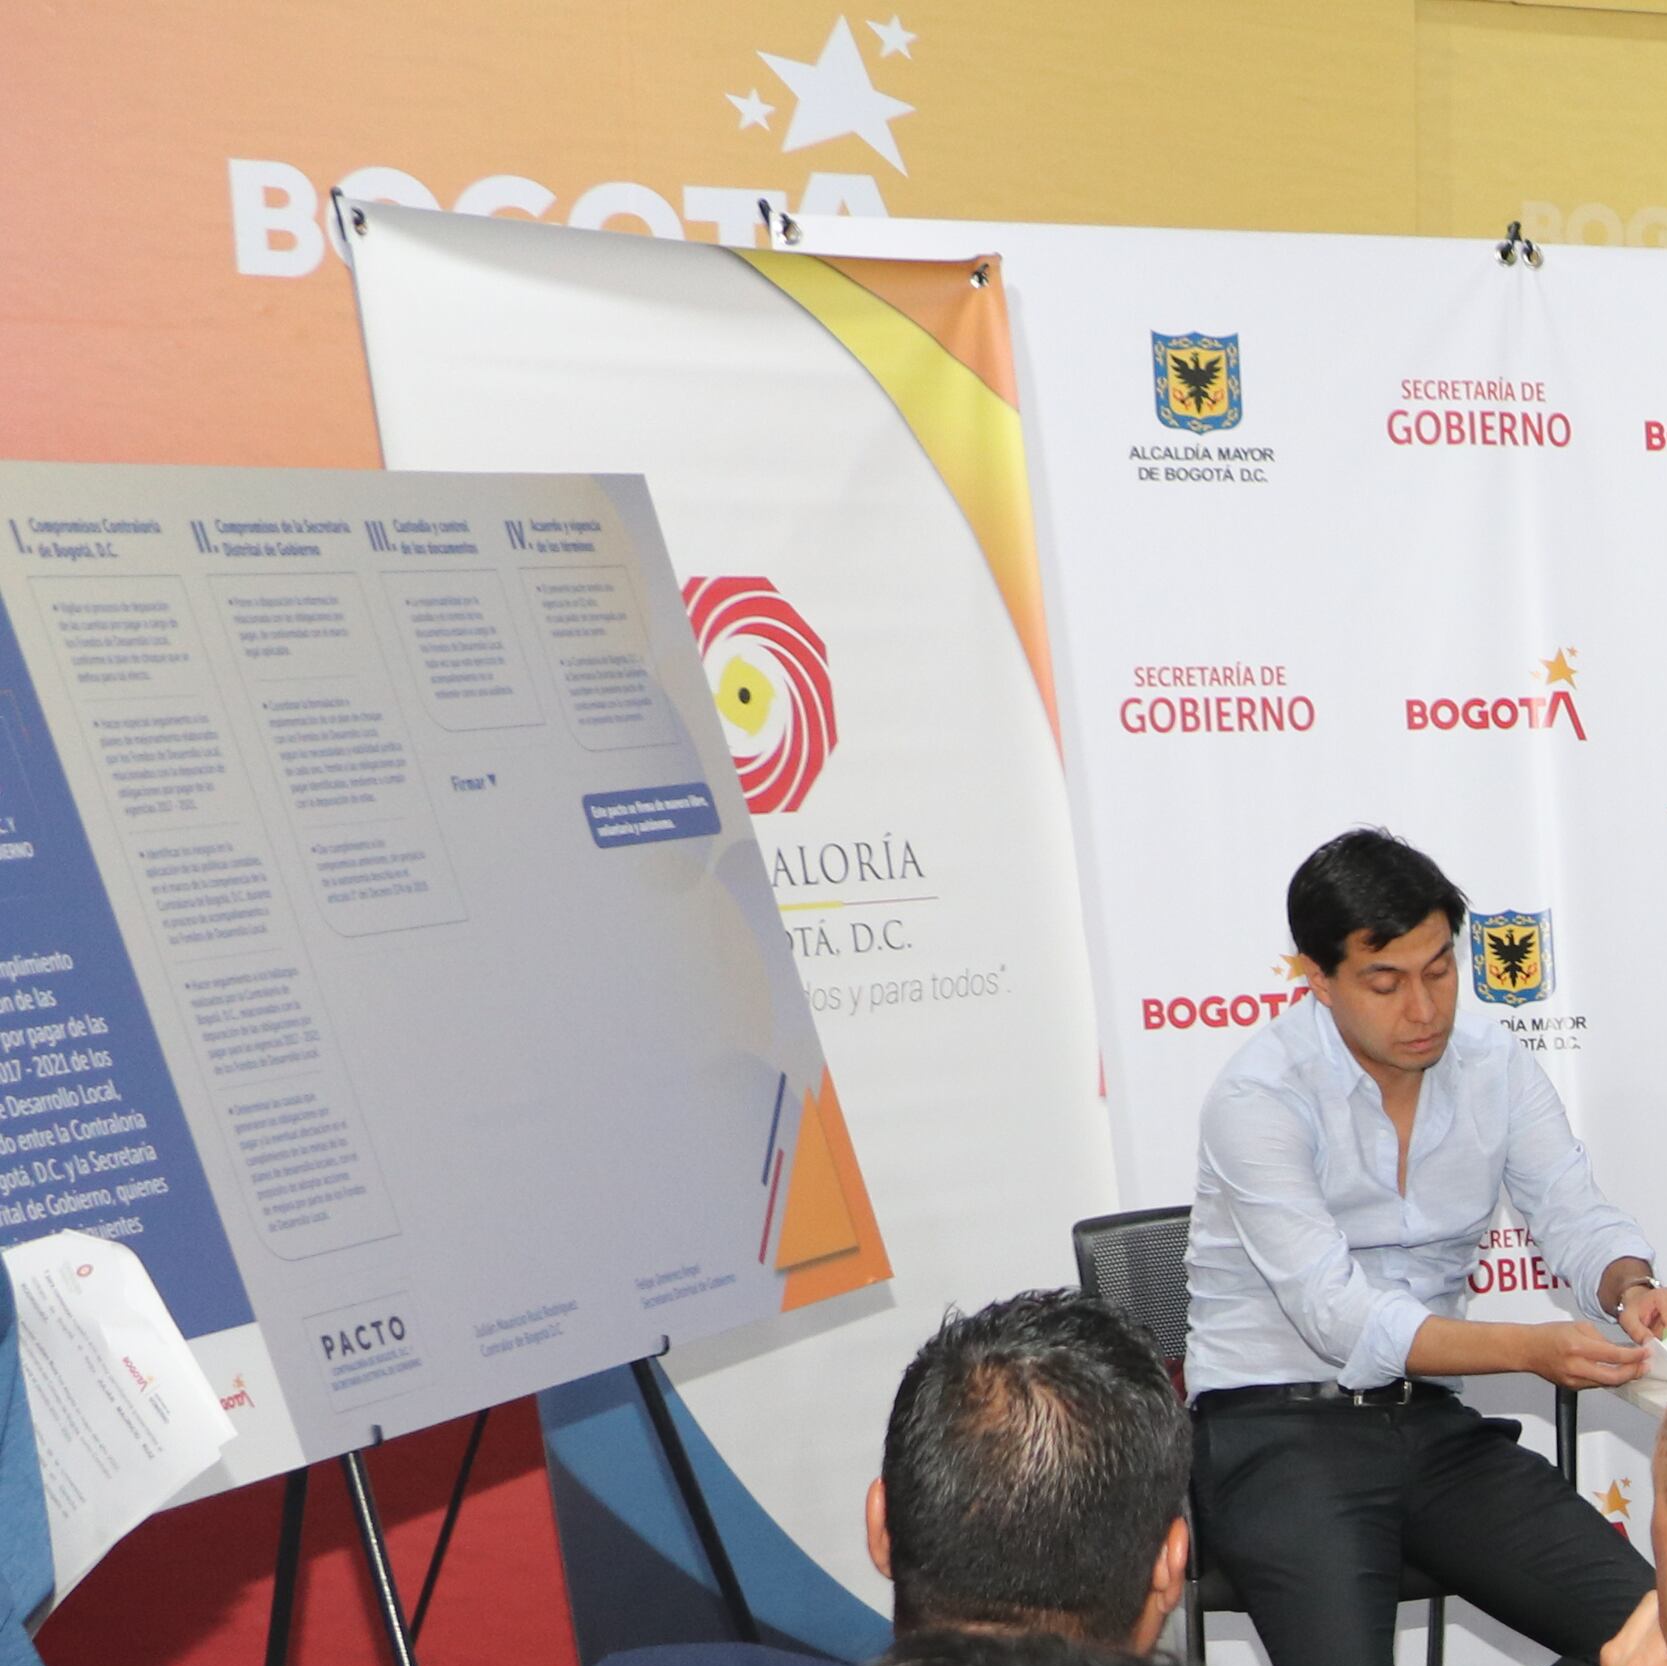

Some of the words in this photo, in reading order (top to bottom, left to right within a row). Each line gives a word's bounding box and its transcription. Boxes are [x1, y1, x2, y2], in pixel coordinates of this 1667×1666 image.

[1401, 376, 1517, 401] SECRETARÍA
[1522, 382, 1546, 402] DE
[1386, 410, 1572, 448] GOBIERNO
[1129, 443, 1212, 462] ALCALDÍA
[1217, 447, 1274, 463] MAYOR
[1138, 467, 1160, 482] DE
[1165, 463, 1233, 483] BOGOTÁ
[1240, 469, 1267, 483] D.C.
[1134, 662, 1255, 687] SECRETARÍA
[1260, 666, 1286, 686] DE
[1119, 695, 1315, 734] GOBIERNO
[785, 918, 840, 957] TÁ,
[850, 919, 912, 953] D.C.
[15, 989, 34, 1011] de
[32, 987, 57, 1007] las
[849, 984, 864, 1016] y
[870, 979, 922, 1013] para
[1, 1030, 25, 1053] por
[27, 1023, 66, 1049] pagar
[68, 1017, 87, 1038] de
[84, 1014, 108, 1034] las
[1531, 1016, 1587, 1032] MAYOR
[32, 1053, 71, 1078] 2021
[71, 1050, 90, 1072] de
[88, 1048, 113, 1068] los
[5, 1087, 79, 1117] Desarrollo
[78, 1079, 122, 1104] Local,
[18, 1128, 56, 1150] entre
[54, 1123, 71, 1144] la
[64, 1162, 75, 1183] y
[73, 1155, 90, 1175] la
[27, 1199, 47, 1221] de
[46, 1189, 116, 1216] Gobierno,
[116, 1177, 169, 1206] quienes
[321, 1316, 405, 1360] PACTO
